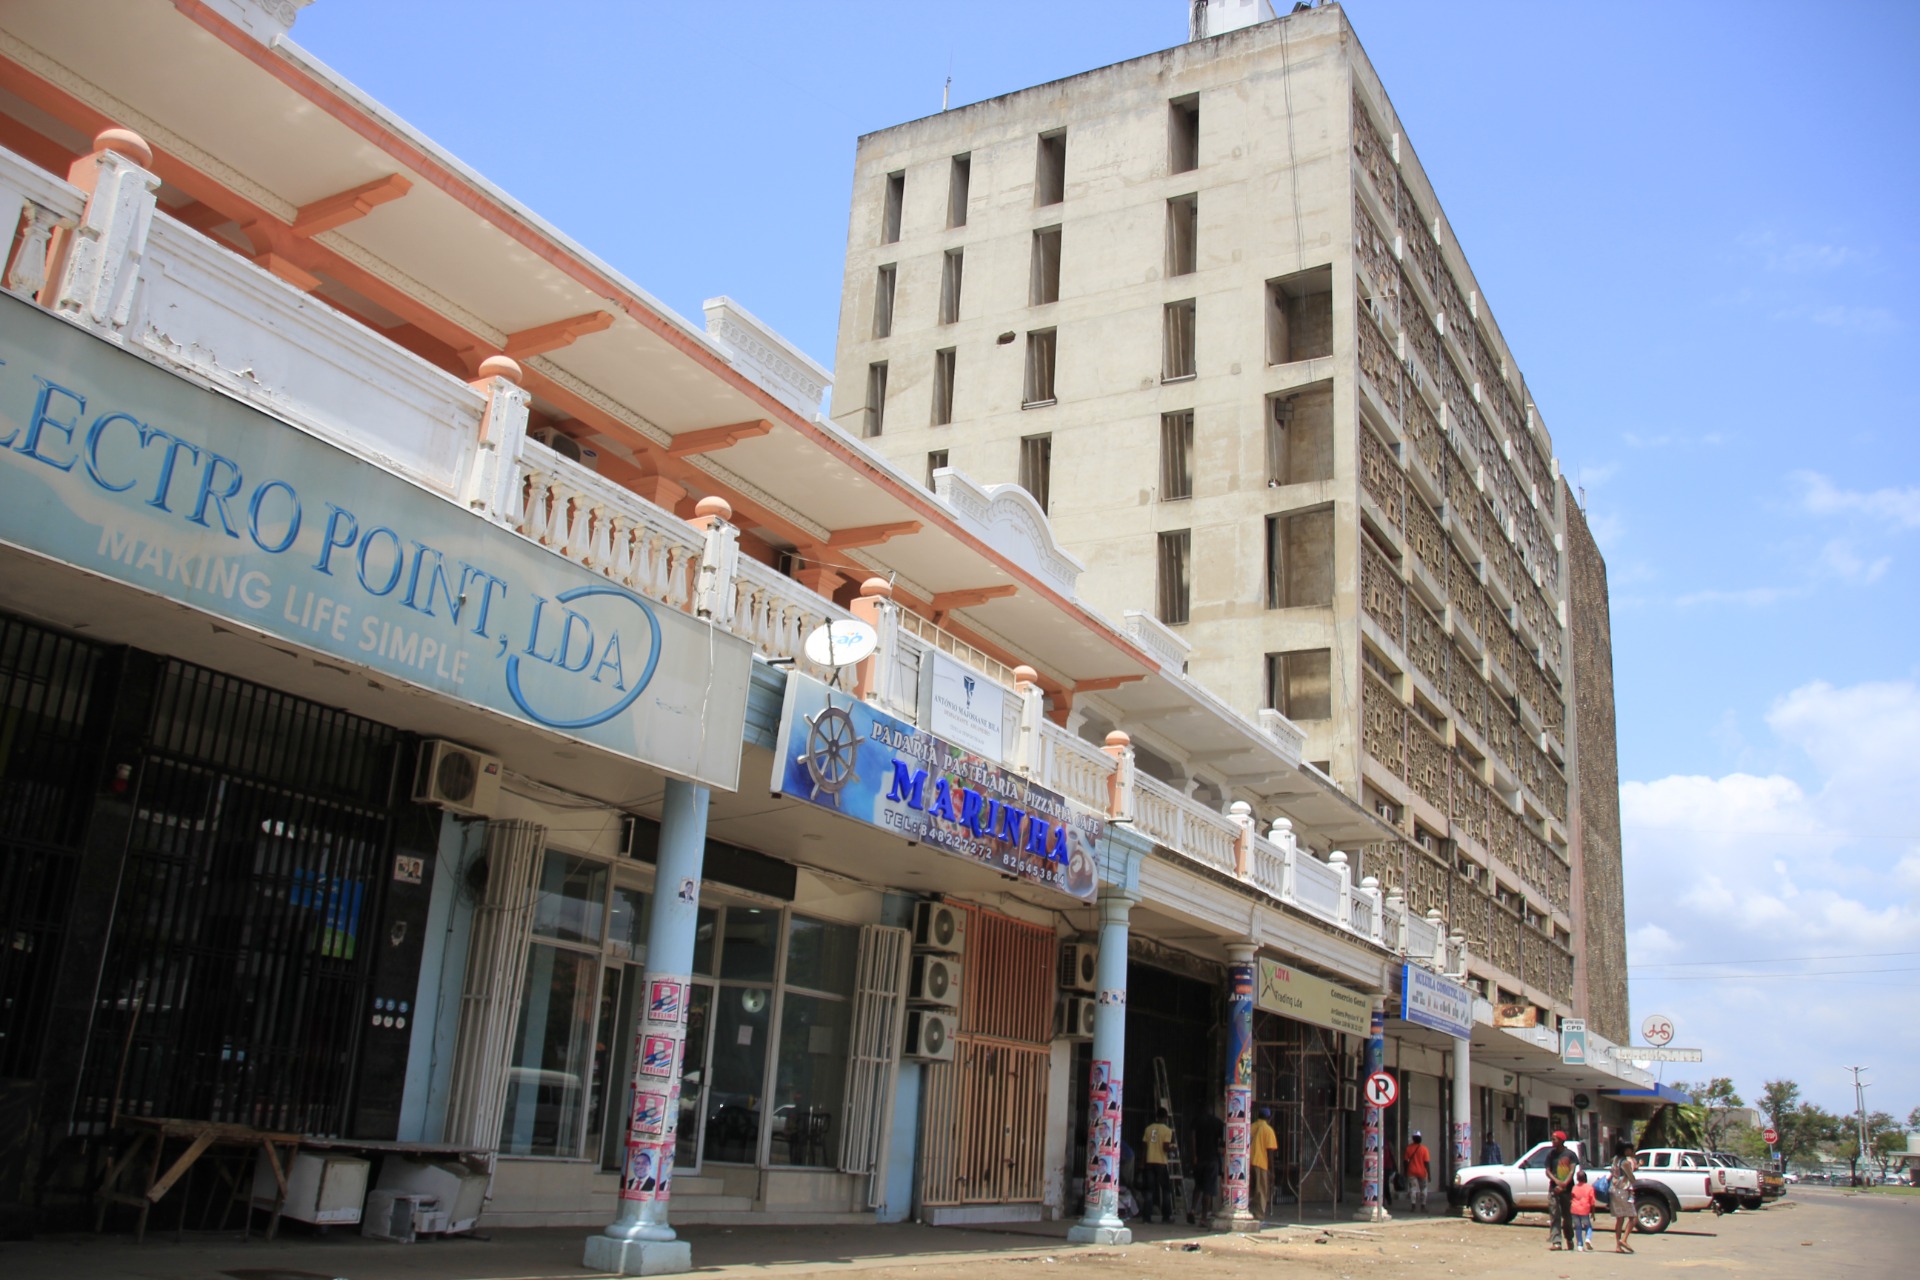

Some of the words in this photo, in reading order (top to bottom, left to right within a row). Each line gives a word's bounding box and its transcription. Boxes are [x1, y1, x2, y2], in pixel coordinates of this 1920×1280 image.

[96, 523, 273, 610] MAKING
[283, 584, 352, 642] LIFE
[358, 615, 469, 685] SIMPLE
[312, 501, 508, 658] POINT,
[522, 593, 626, 692] LDA
[870, 720, 939, 766] PADARIA
[943, 754, 1019, 800] PASTELARIA
[1023, 789, 1073, 825] PIZZARIA
[886, 758, 1069, 867] MARINHA
[1003, 854, 1065, 884] 826453844
[1375, 1078, 1389, 1100] P
[1763, 1132, 1776, 1140] STOP
